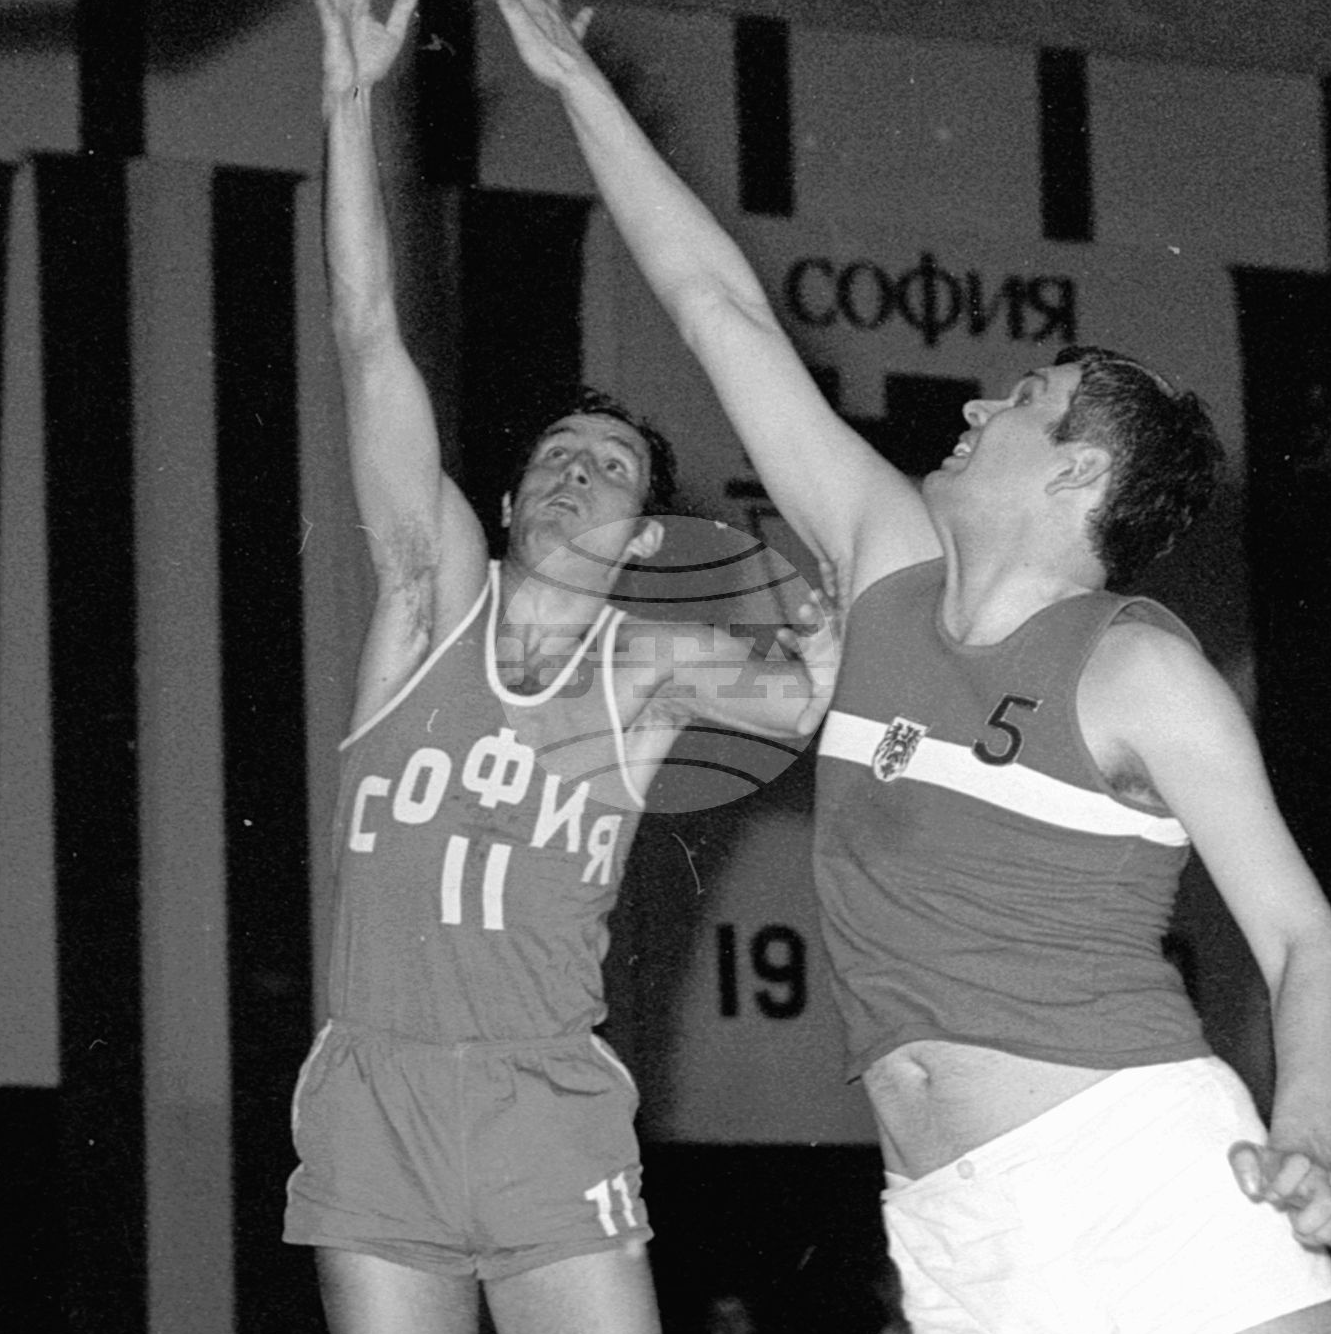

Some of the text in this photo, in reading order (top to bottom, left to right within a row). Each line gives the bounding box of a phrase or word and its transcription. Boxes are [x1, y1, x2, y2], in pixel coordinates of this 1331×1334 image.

[782, 252, 1077, 347] СОФИЯ
[971, 693, 1042, 768] 5
[349, 727, 622, 886] СОФИЯ
[441, 835, 511, 930] 11
[584, 1172, 637, 1236] 11
